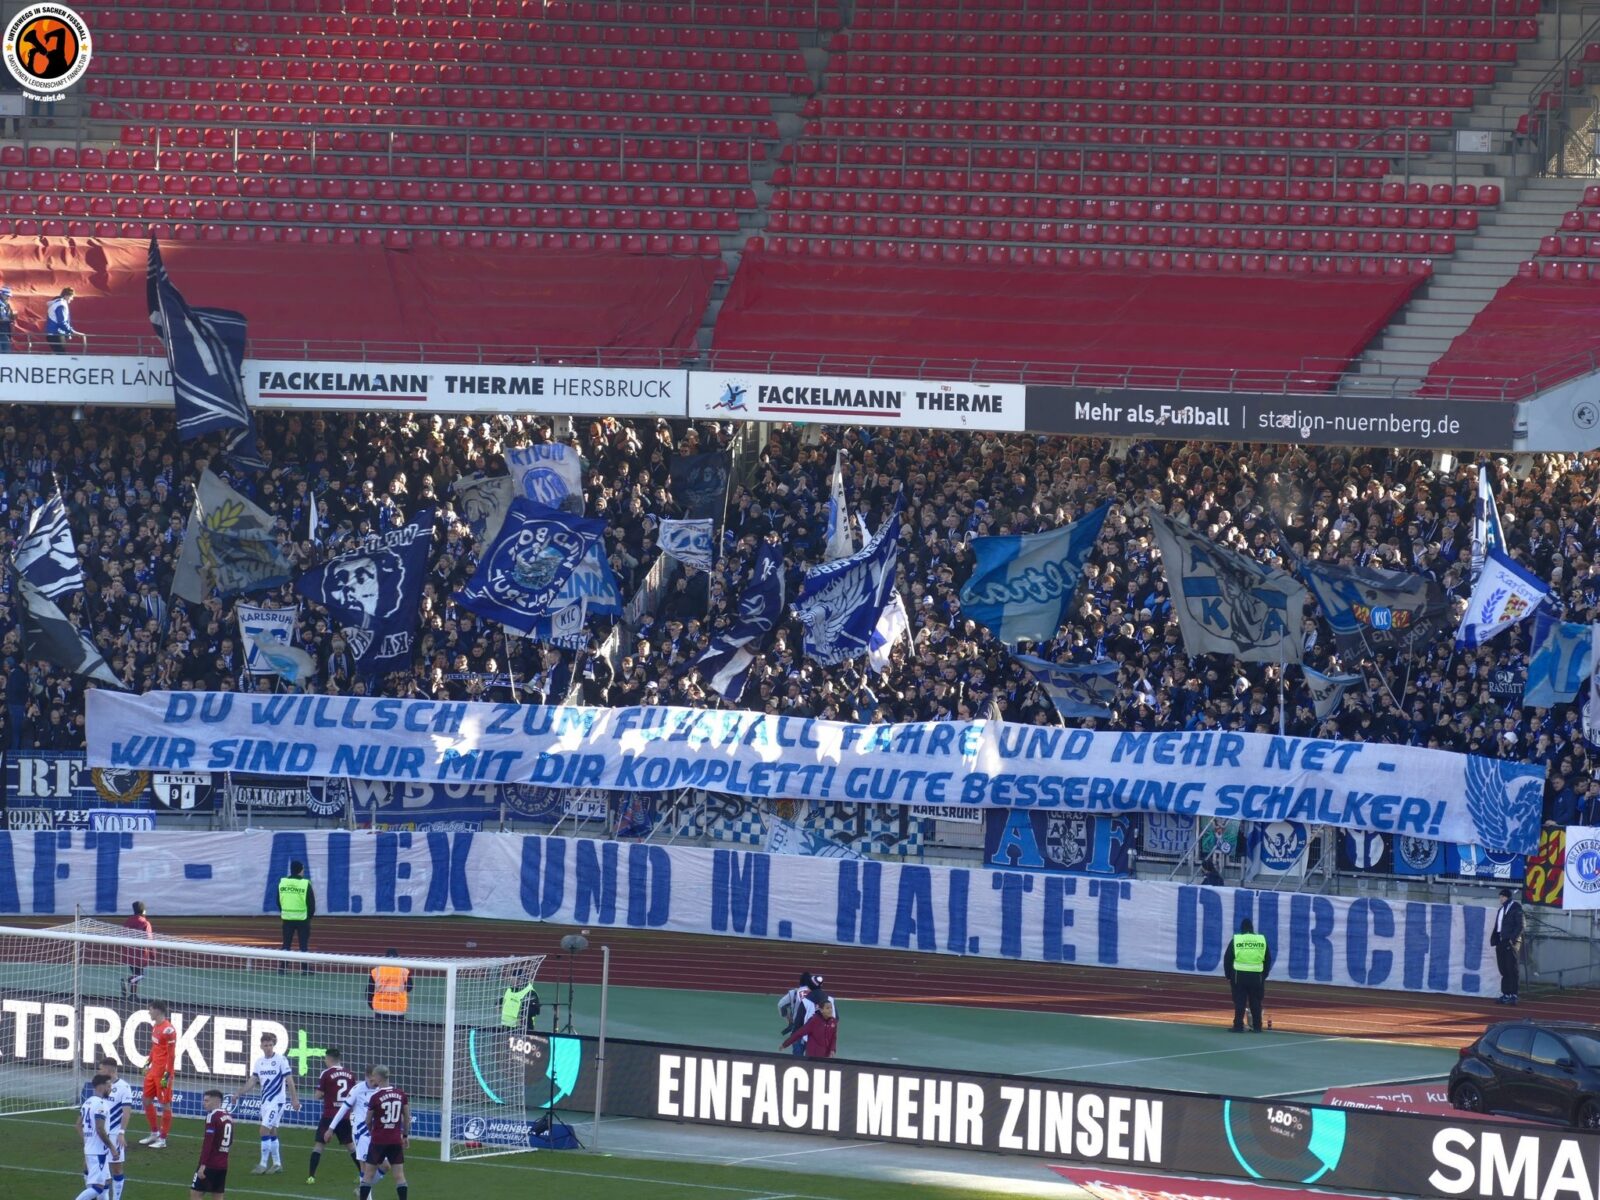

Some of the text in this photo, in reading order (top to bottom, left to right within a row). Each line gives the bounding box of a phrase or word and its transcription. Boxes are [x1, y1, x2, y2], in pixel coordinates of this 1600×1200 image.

[259, 371, 671, 399] FACKELMANN THERME HERSBRUCK
[758, 385, 1003, 413] FACKELMANN THERME
[1075, 401, 1460, 439] Mehr als Fußball stadion-nuernberg.de
[1489, 682, 1523, 694] RASTATT
[164, 692, 233, 724] DU
[251, 695, 467, 733] WILLSCH
[485, 703, 595, 738] ZUM
[841, 723, 985, 757] FAHRE
[999, 726, 1094, 761] UND
[1111, 731, 1245, 768] MEHR
[1263, 735, 1363, 775] NET
[16, 758, 83, 798] RF
[110, 735, 1447, 835] WIR SIND NUR MIT DIR KOMPLETT! GUTE BESSERUNG SCHALKER!
[9, 810, 51, 824] ODEN
[94, 815, 153, 831] NORD
[913, 804, 981, 820] KARLSRUHE
[262, 831, 474, 914] ALEX
[520, 835, 672, 927] UND
[711, 849, 792, 938] M.
[836, 859, 1131, 965] HALTET
[1175, 884, 1487, 994] DURCH!
[336, 1079, 348, 1102] 2
[269, 1110, 276, 1120] 6
[380, 1100, 402, 1124] 30
[657, 1053, 1163, 1164] EINFACH MEHR ZINSEN
[1266, 1107, 1303, 1130] 1,80%
[221, 1122, 232, 1147] 9
[1428, 1127, 1600, 1199] SMA
